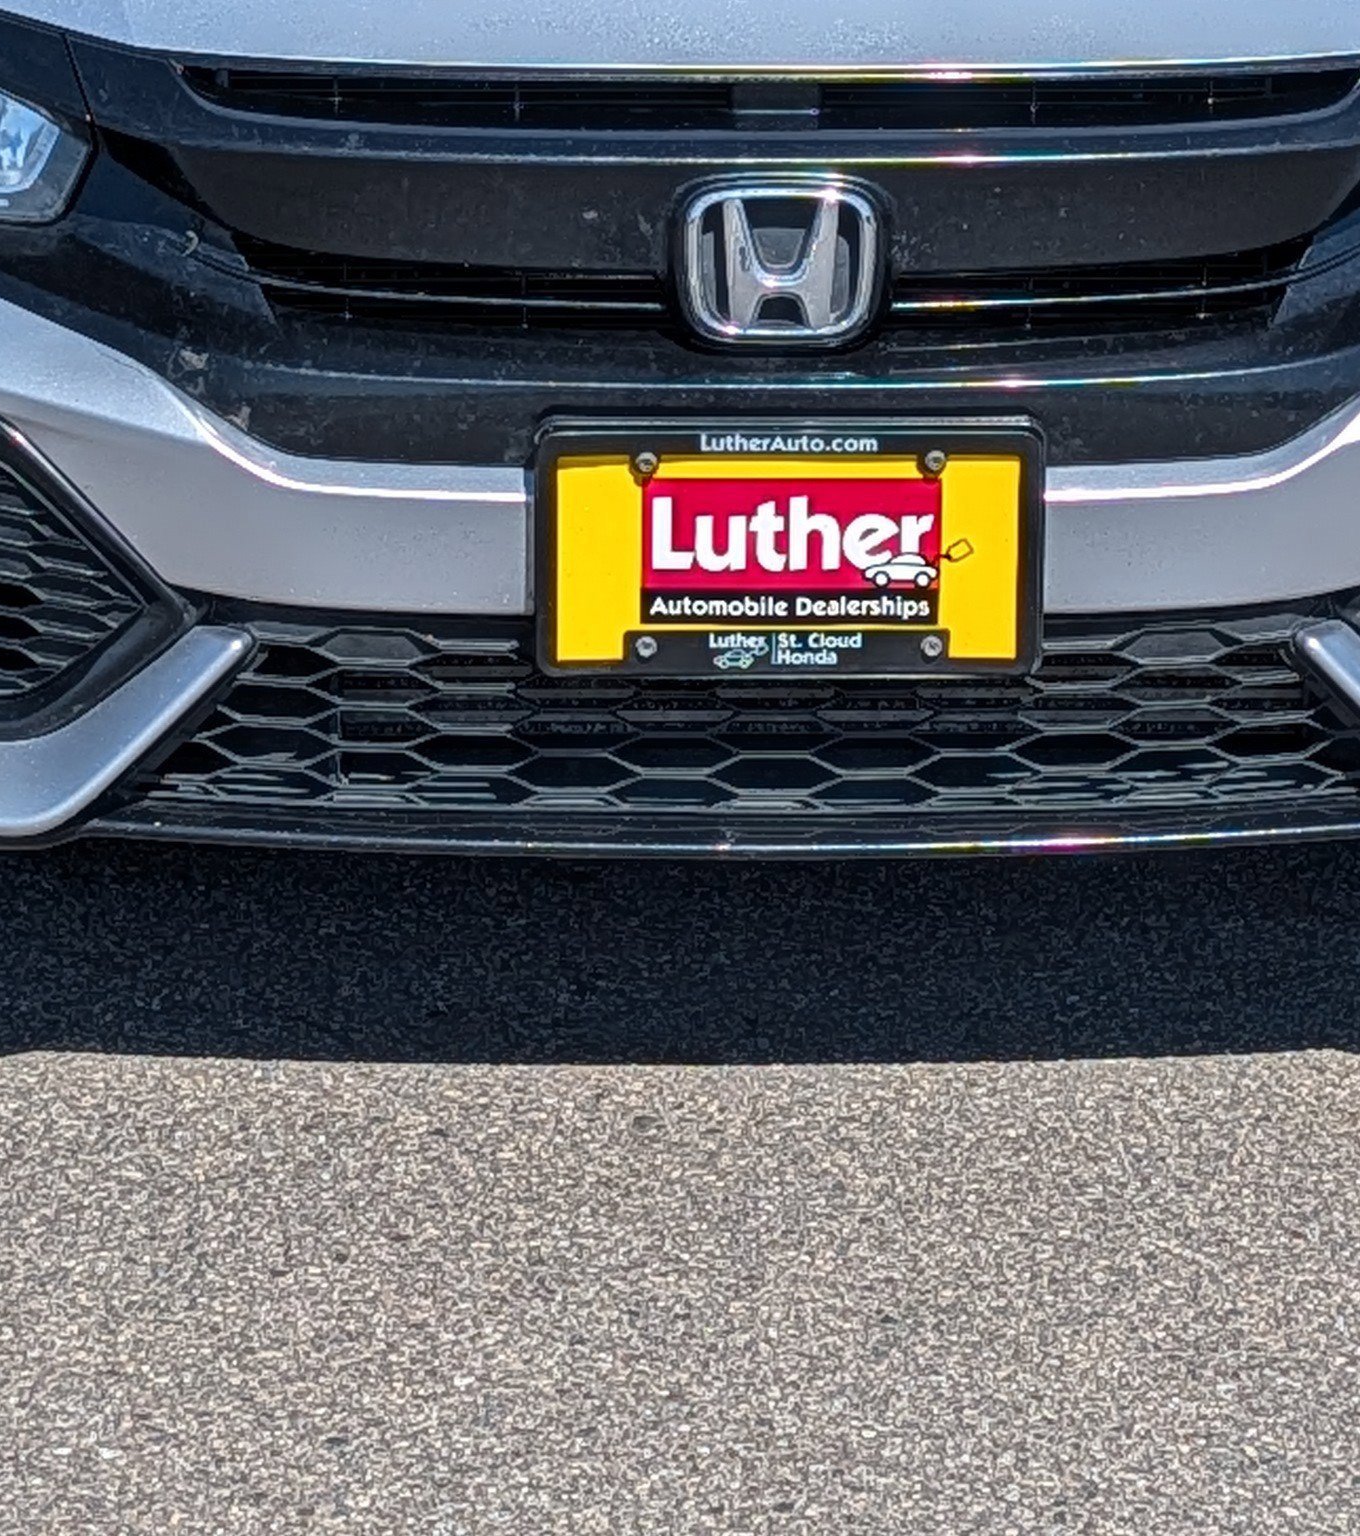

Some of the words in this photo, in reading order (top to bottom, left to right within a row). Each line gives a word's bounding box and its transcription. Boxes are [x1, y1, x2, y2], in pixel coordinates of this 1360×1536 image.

[700, 434, 878, 452] LutherAuto.com
[652, 496, 934, 571] Luther
[650, 596, 788, 616] Automobile
[796, 596, 930, 620] Dealerships
[709, 632, 767, 649] Luther
[778, 632, 802, 648] St.
[808, 632, 862, 648] Cloud
[778, 649, 837, 664] Honda
